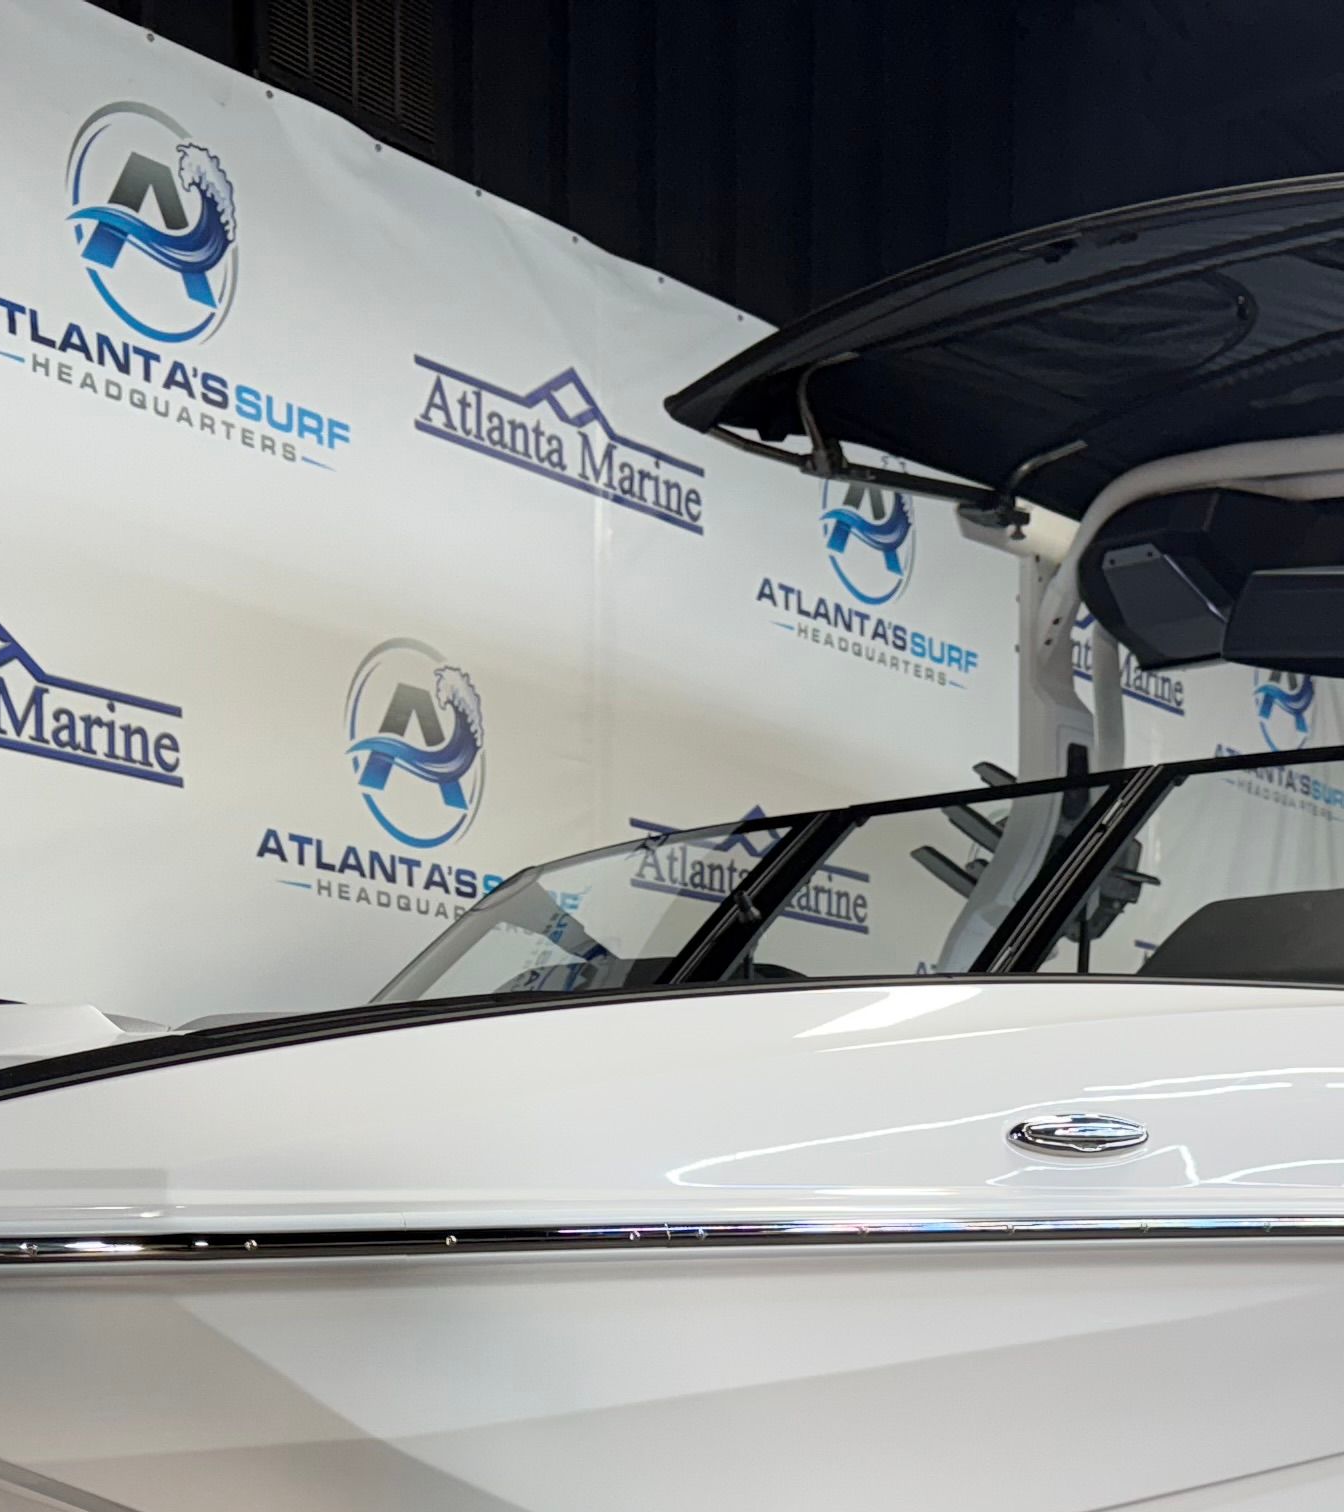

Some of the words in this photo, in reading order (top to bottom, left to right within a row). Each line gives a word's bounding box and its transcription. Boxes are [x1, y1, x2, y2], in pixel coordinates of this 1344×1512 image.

[31, 353, 297, 463] HEADQUARTERS
[419, 374, 567, 472] Atlanta
[577, 430, 702, 523] Marine
[796, 622, 948, 687] HEADQUARTERS
[787, 874, 868, 924] arine
